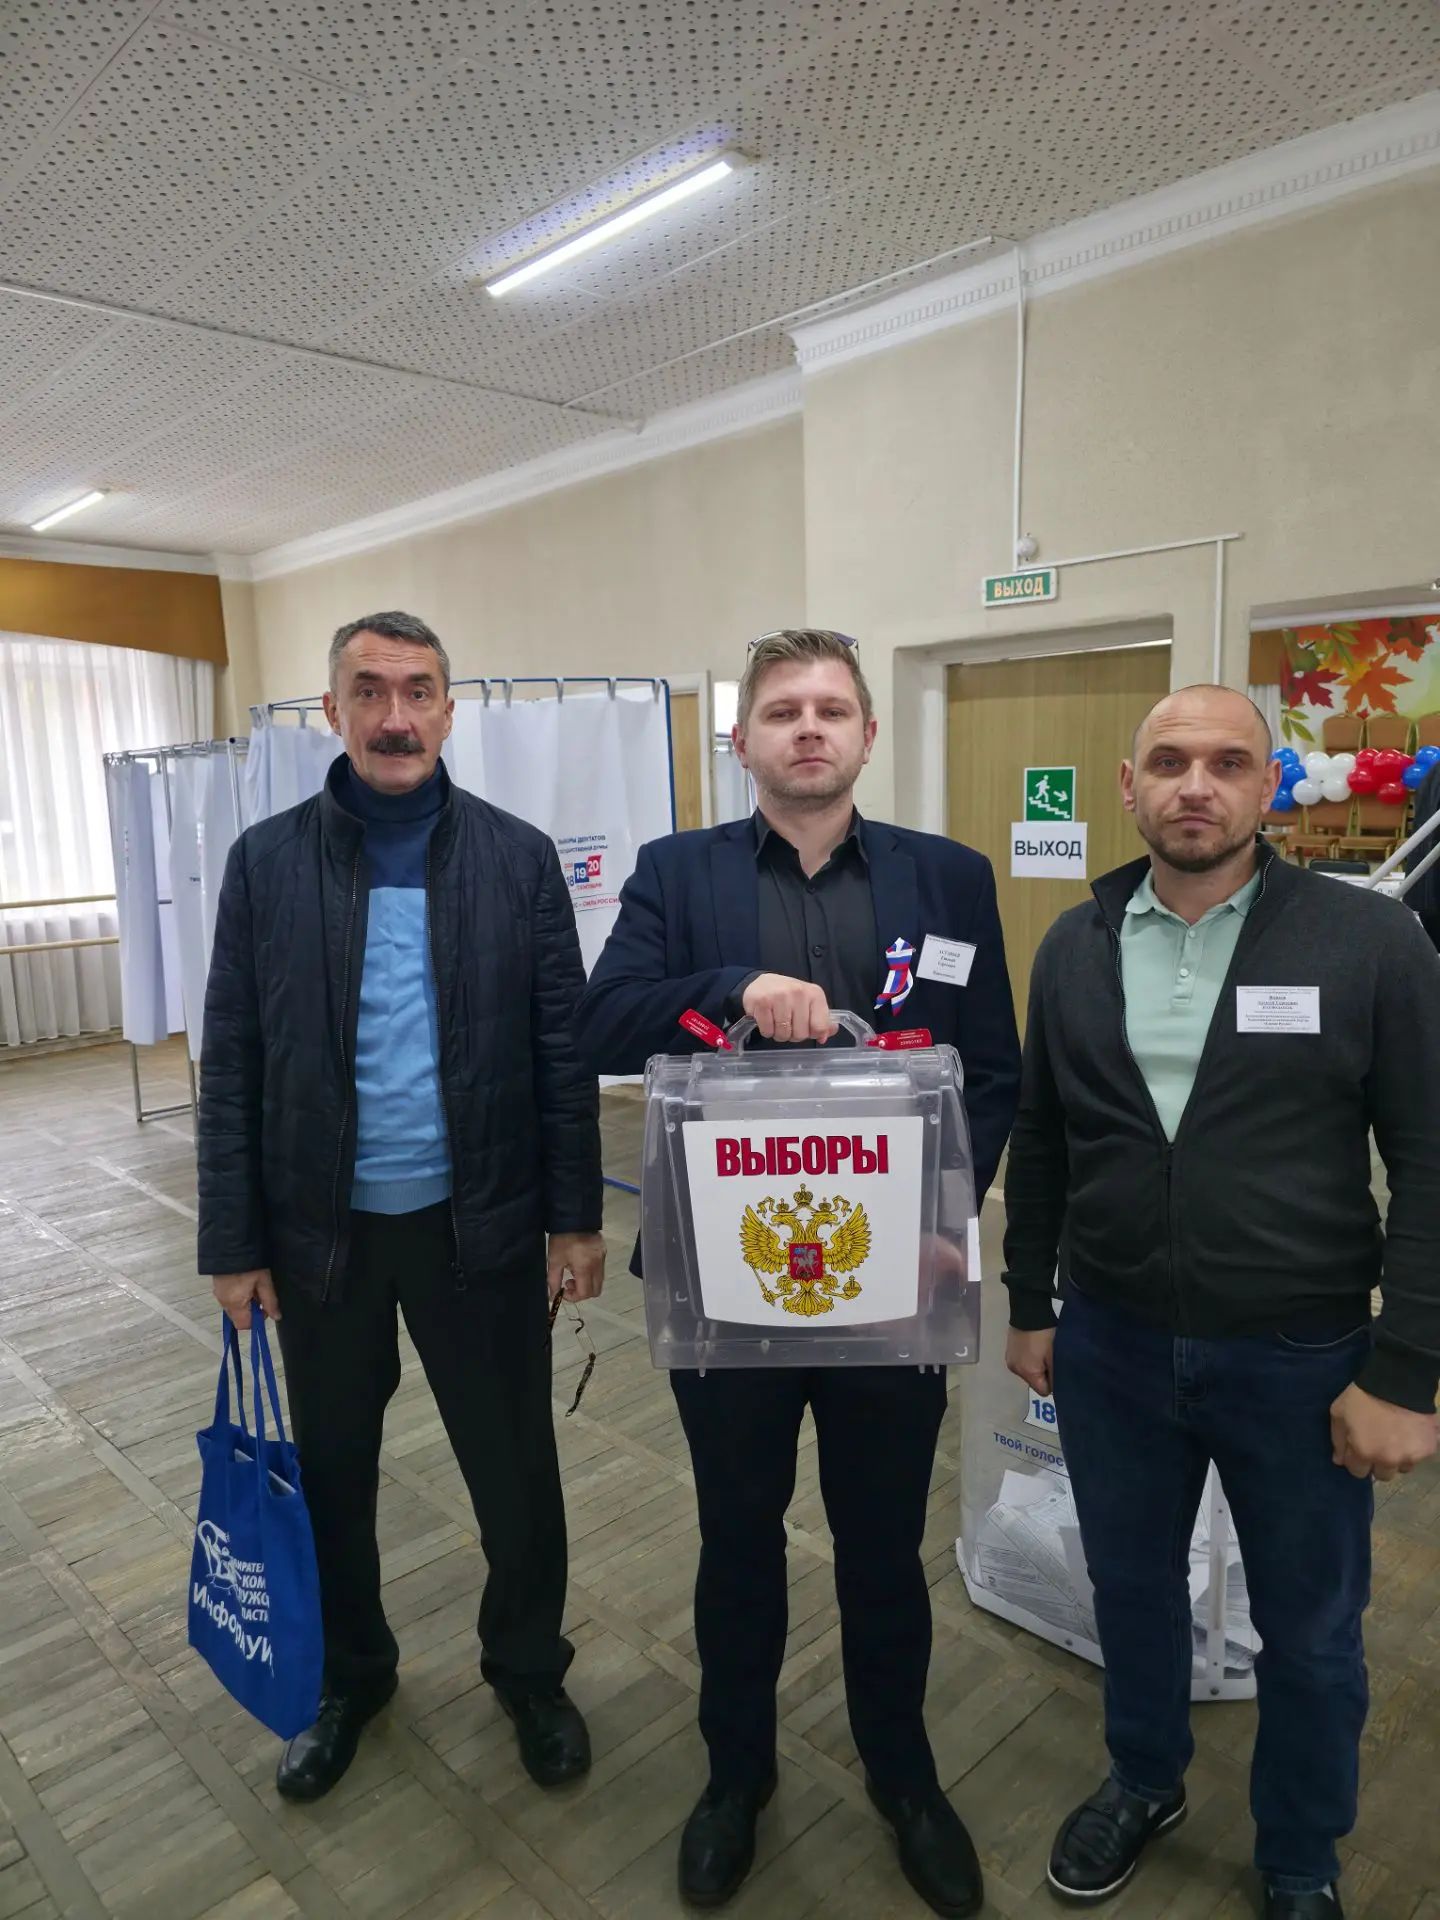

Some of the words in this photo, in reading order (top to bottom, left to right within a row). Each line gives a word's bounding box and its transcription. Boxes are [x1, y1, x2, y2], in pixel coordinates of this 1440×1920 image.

[994, 576, 1044, 598] ВЫХОД
[1014, 840, 1082, 860] ВЫХОД
[575, 867, 587, 880] 19
[587, 859, 600, 873] 20
[715, 1135, 889, 1177] ВЫБОРЫ
[1032, 1399, 1057, 1424] 18
[993, 1431, 1022, 1452] ТВОЙ
